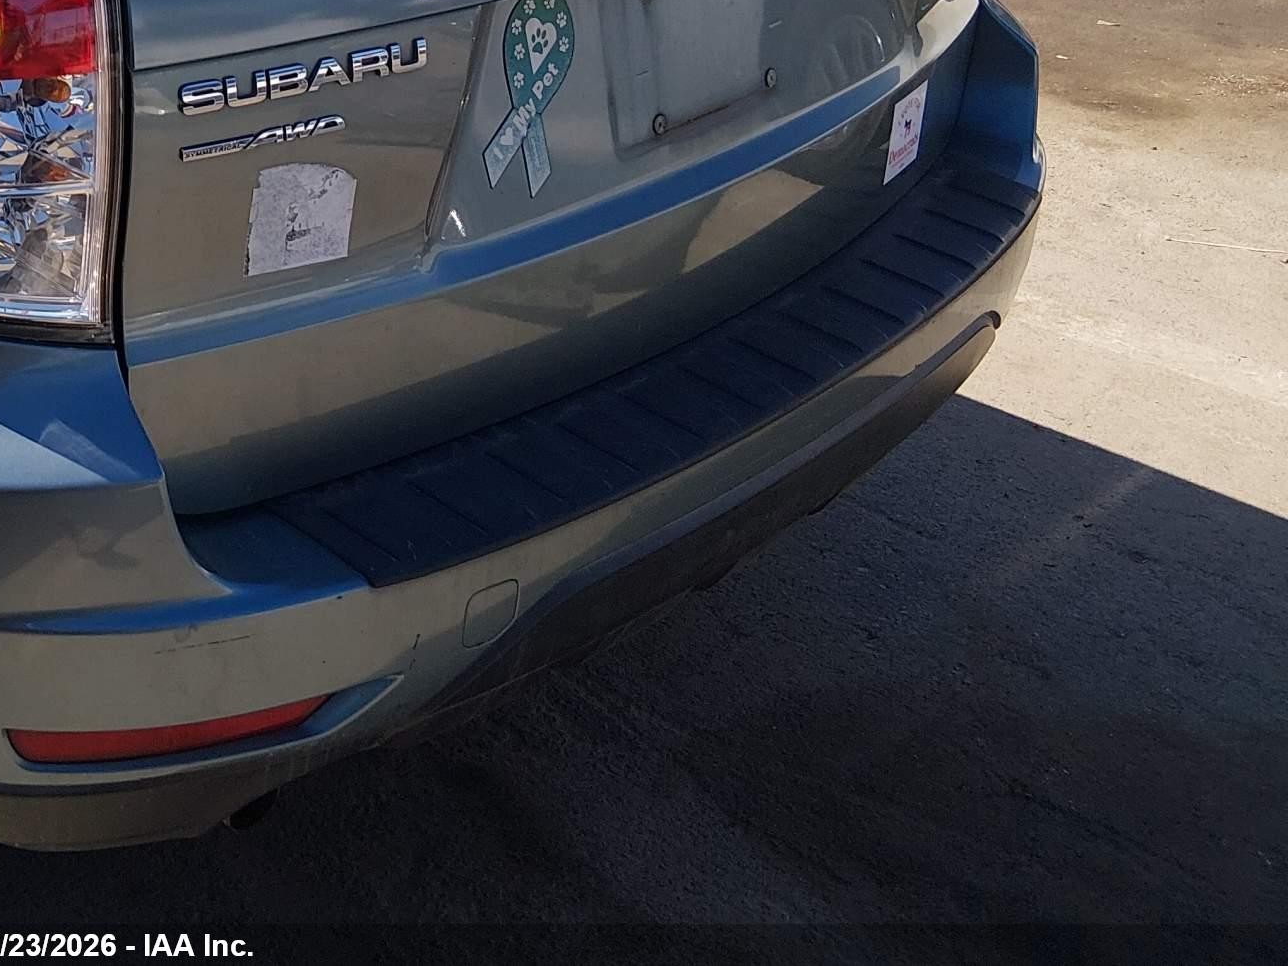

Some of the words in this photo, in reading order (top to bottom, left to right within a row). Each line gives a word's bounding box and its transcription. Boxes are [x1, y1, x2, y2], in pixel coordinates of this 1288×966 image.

[178, 37, 428, 116] SUBARU
[513, 97, 537, 138] My
[532, 61, 559, 101] Pet
[244, 114, 347, 150] AWD
